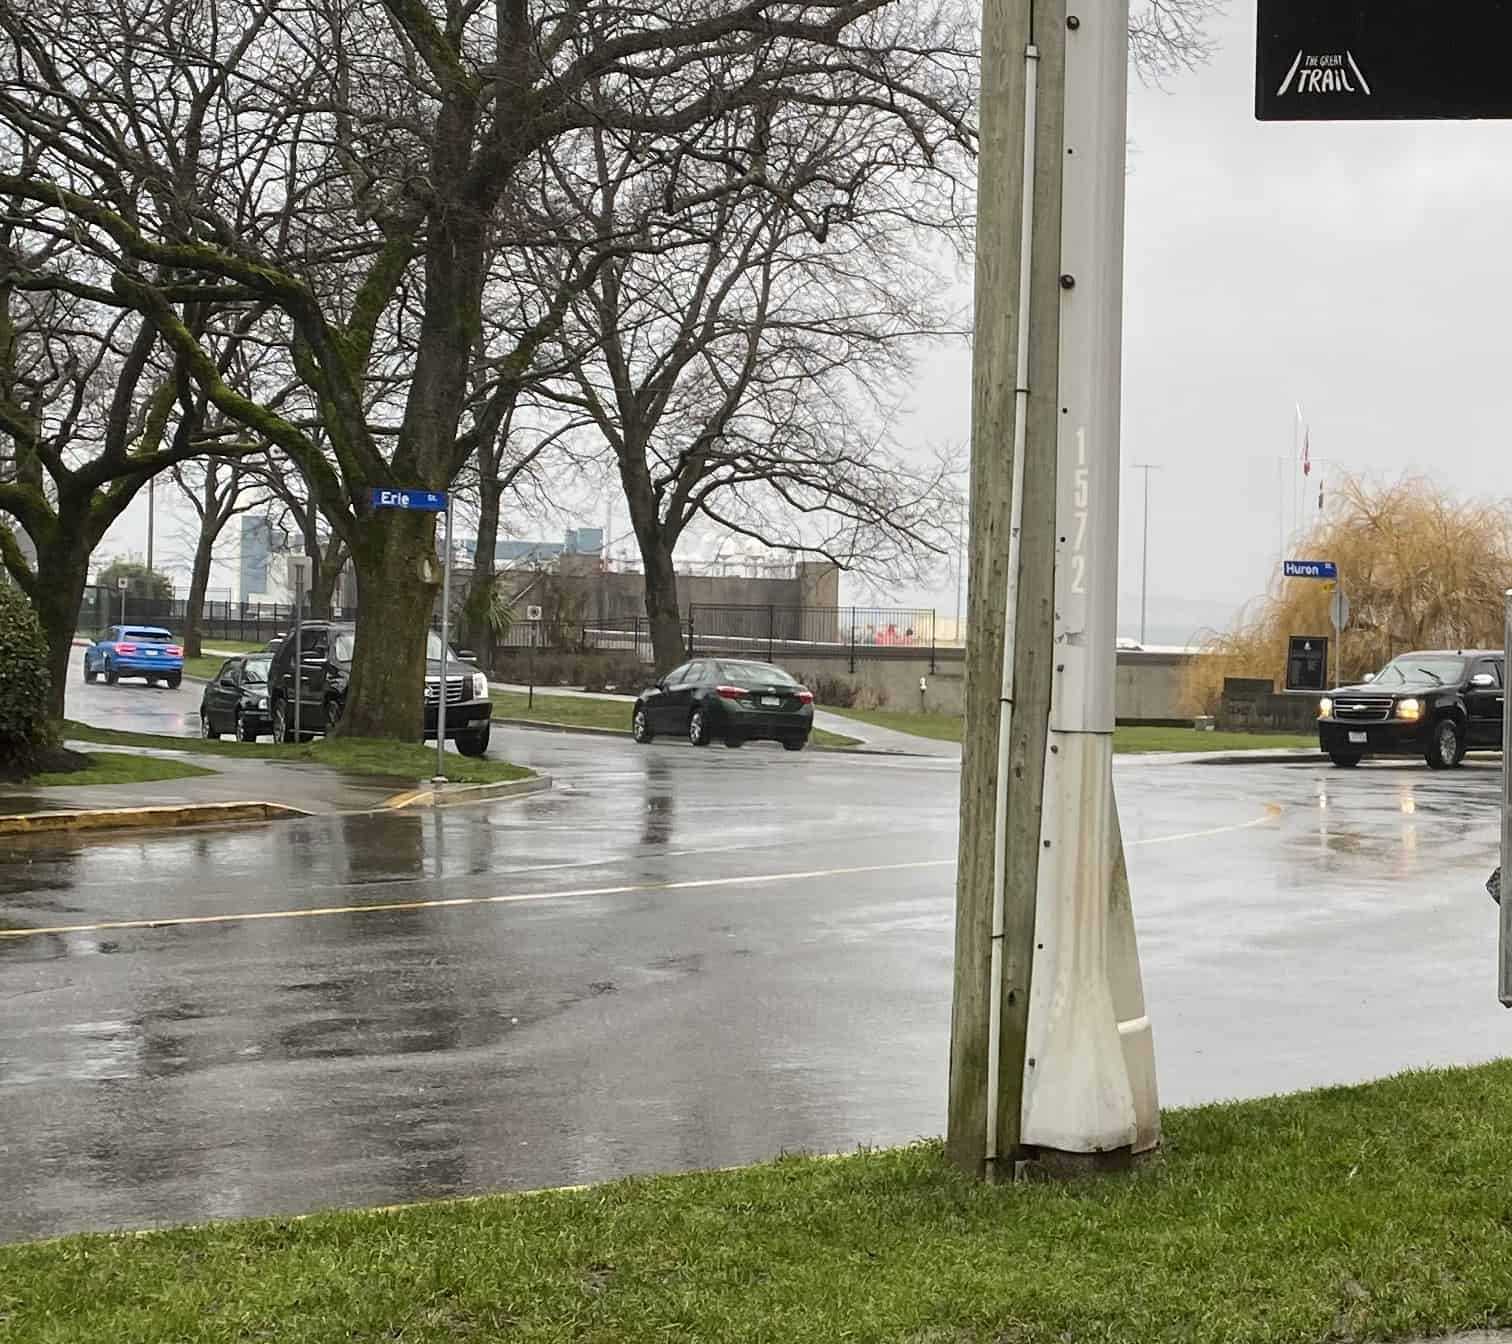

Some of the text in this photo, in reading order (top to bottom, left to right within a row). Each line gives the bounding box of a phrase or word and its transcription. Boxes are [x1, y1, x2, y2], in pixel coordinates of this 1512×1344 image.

[1320, 55, 1343, 67] GREAT
[381, 491, 410, 506] Erie
[1071, 425, 1089, 594] 1572
[1286, 562, 1319, 575] Huron
